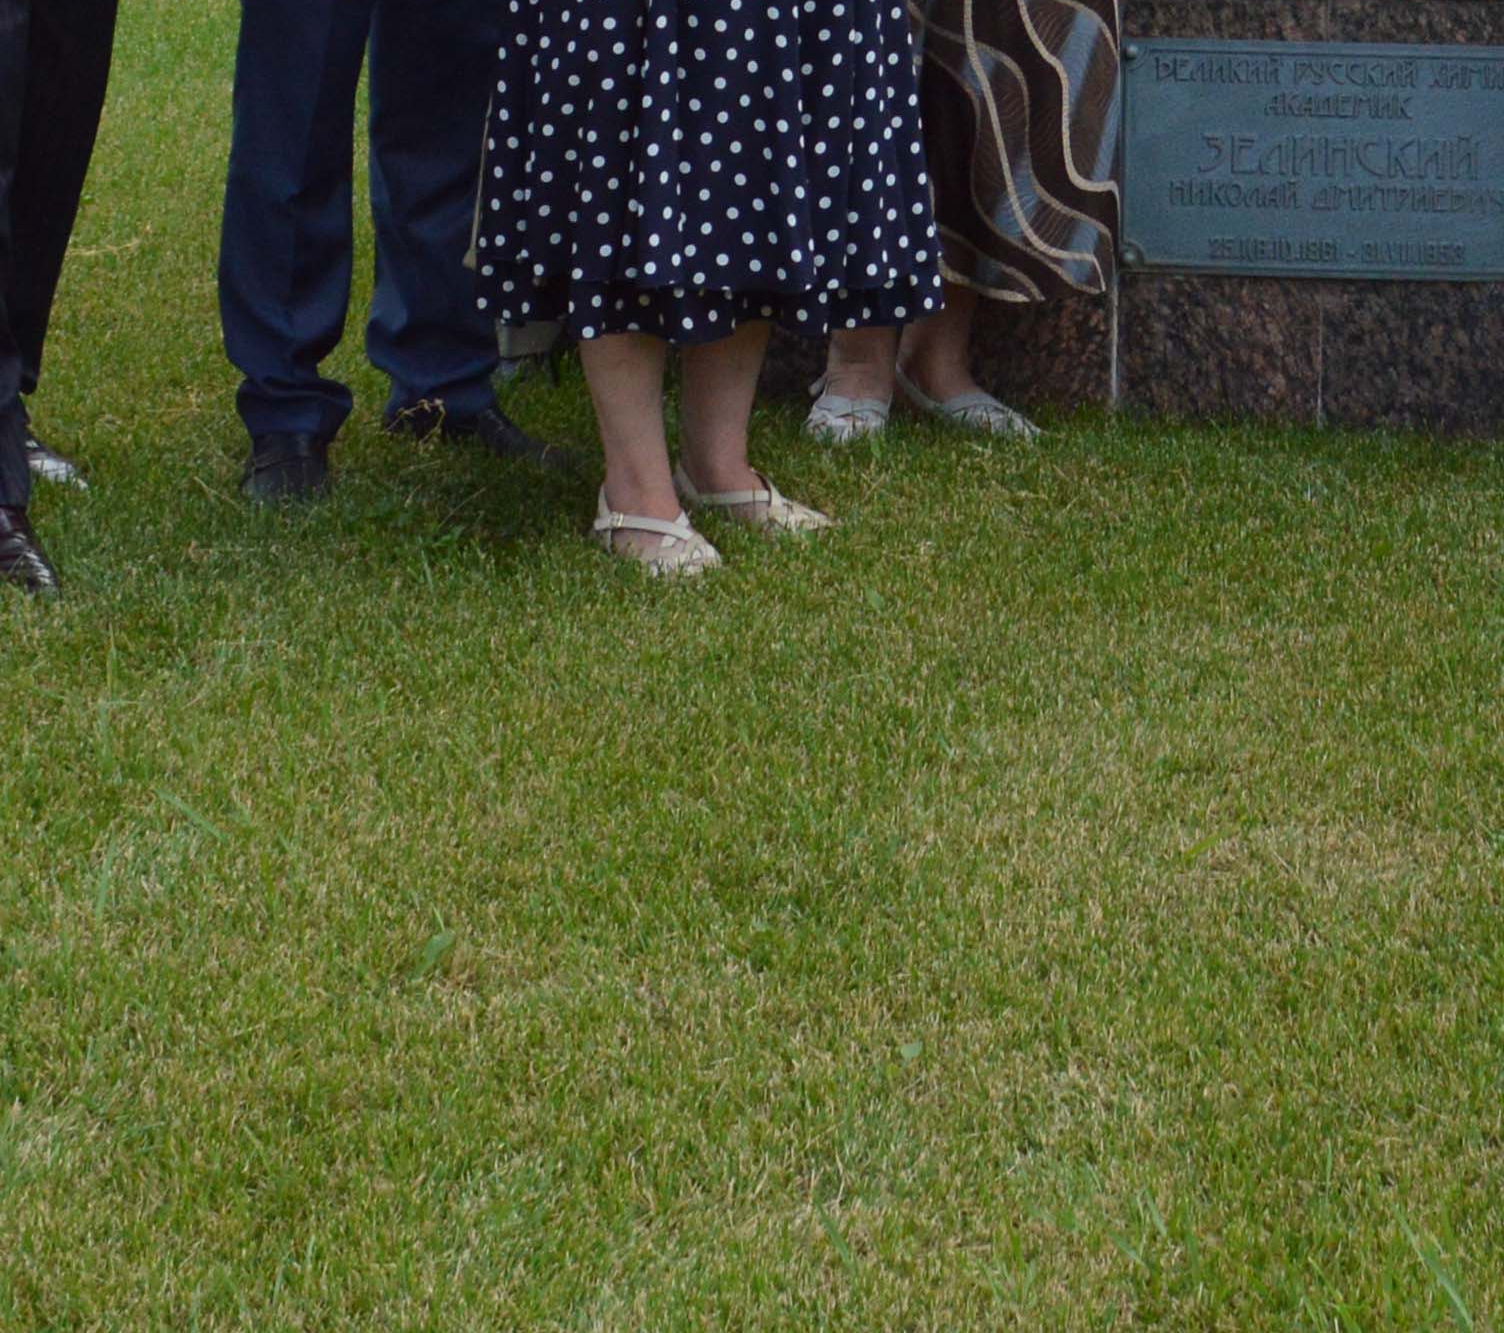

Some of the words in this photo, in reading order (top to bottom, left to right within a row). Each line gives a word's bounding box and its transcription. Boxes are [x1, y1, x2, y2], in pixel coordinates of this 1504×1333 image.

[1153, 53, 1281, 86] ВЕЛИКИЙ
[1292, 58, 1418, 88] РУССКИЙ
[1263, 91, 1413, 120] АКАДЕМИК
[1197, 131, 1482, 181] ЗЕЛИНСКИЙ
[1169, 179, 1301, 210] НИКОЛАЙ
